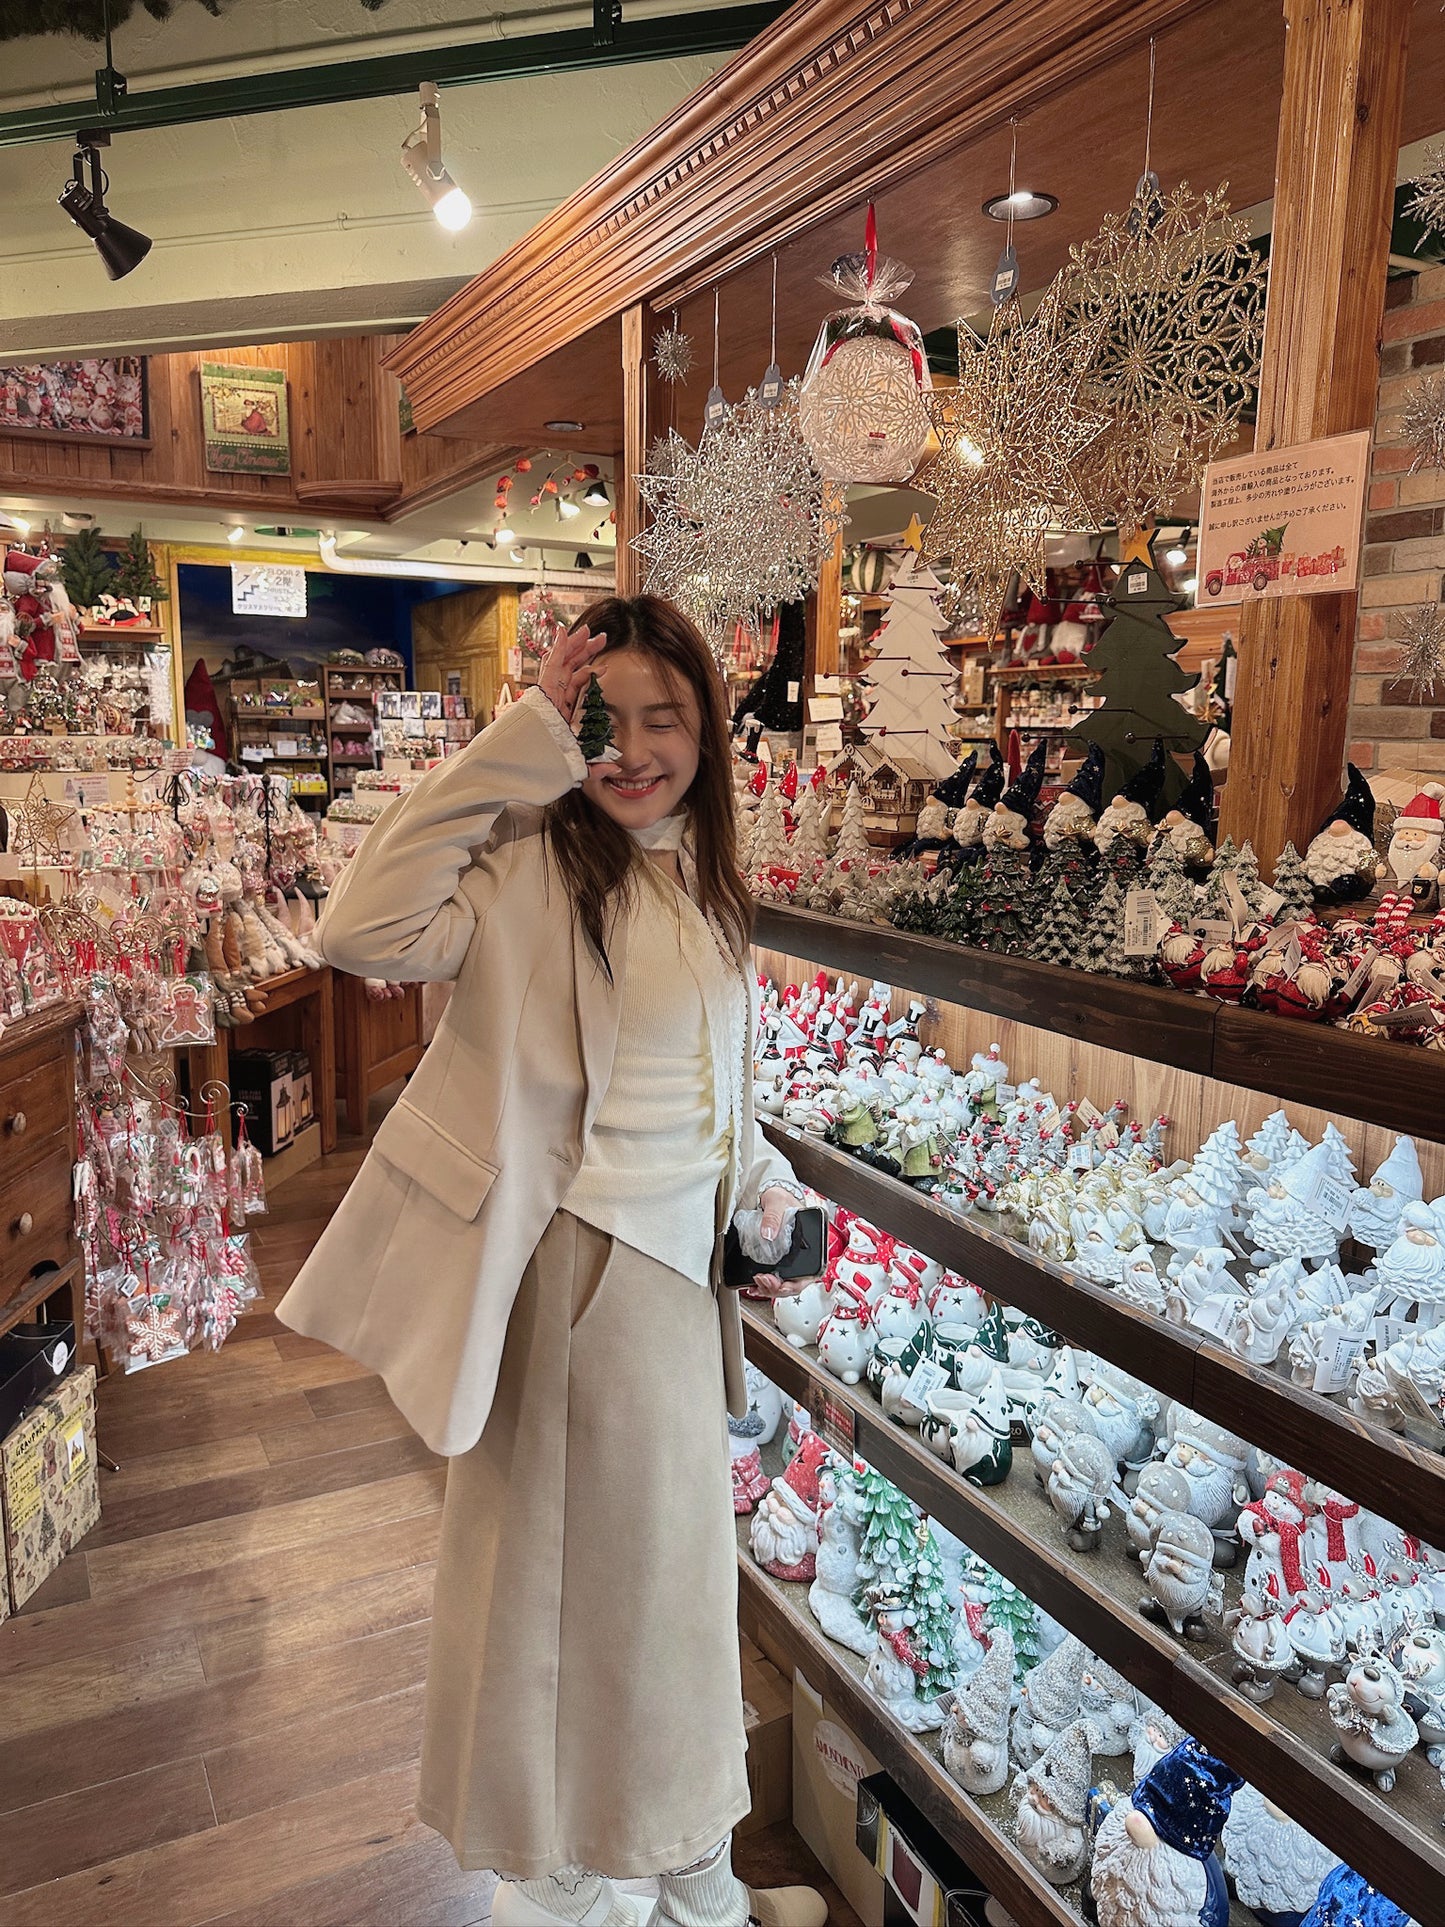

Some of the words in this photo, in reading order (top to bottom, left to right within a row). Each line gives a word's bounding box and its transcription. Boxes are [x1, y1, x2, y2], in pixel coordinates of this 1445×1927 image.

[1212, 461, 1299, 486] 当店で販売している商品は全て
